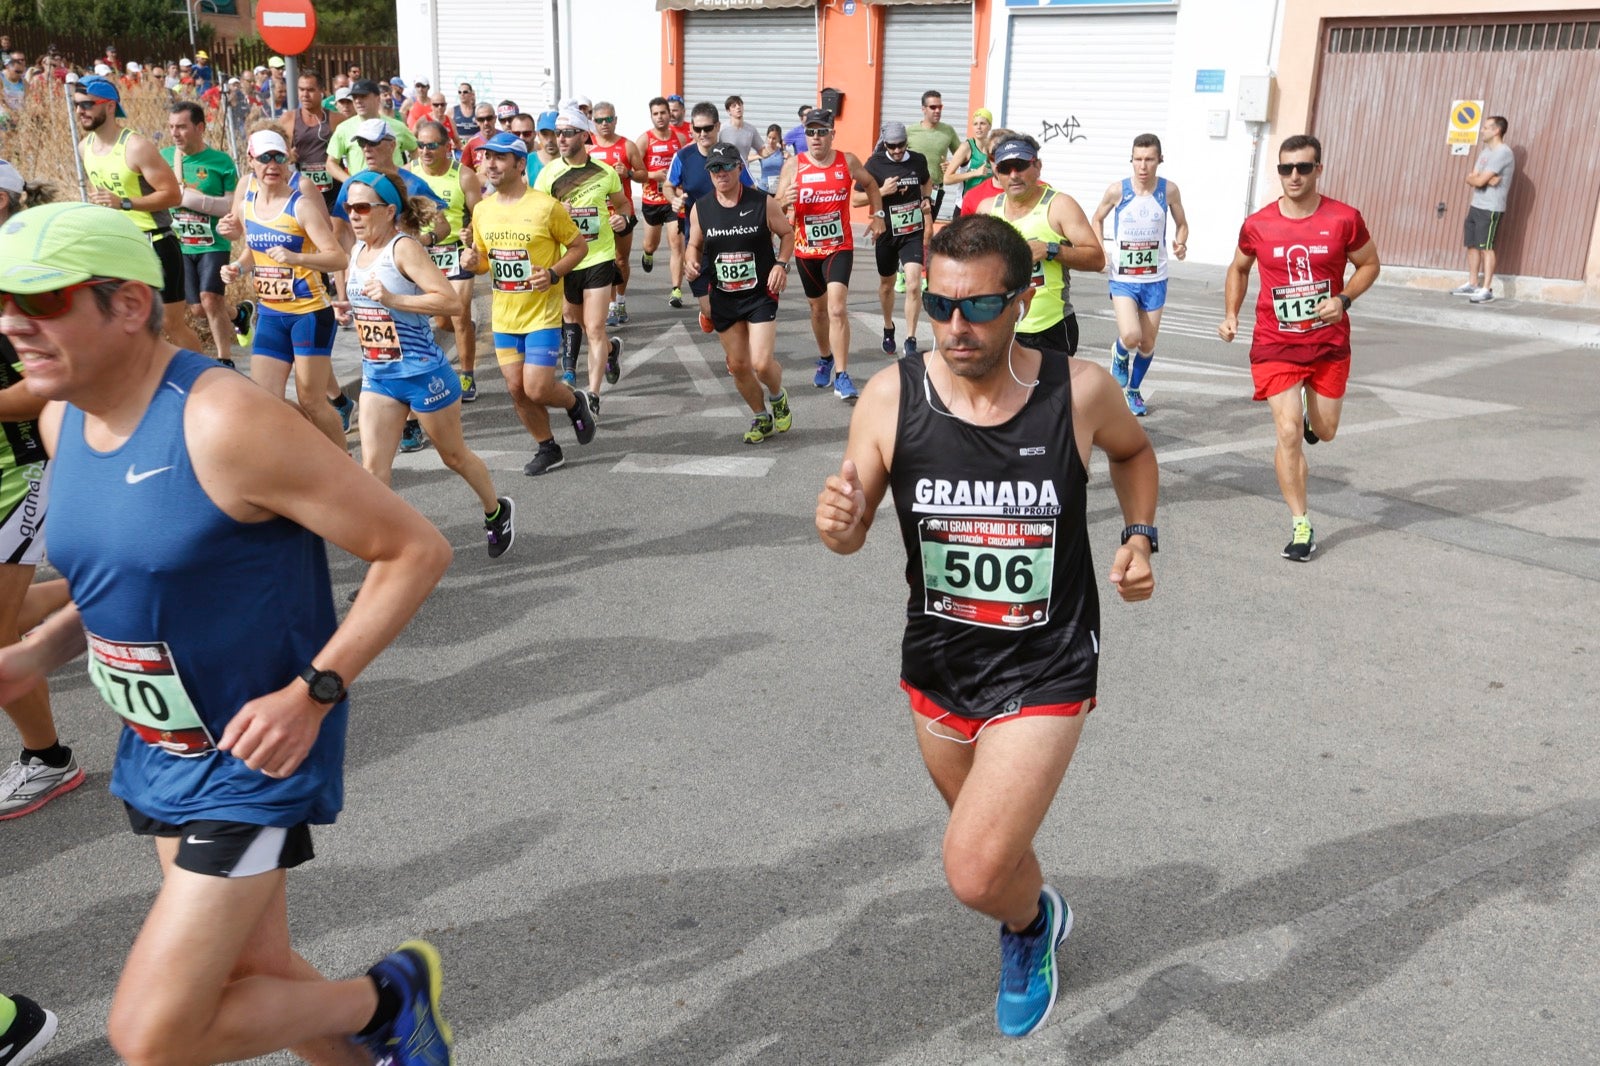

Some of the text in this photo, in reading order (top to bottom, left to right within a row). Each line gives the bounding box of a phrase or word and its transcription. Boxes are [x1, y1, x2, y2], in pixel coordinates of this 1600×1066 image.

[799, 187, 849, 204] Polisalud
[898, 210, 915, 225] 27
[178, 223, 206, 236] 763
[485, 229, 531, 242] agustinos
[706, 225, 759, 238] Almuñécar
[811, 223, 838, 239] 600
[1127, 251, 1152, 265] 134
[495, 262, 524, 278] 806
[721, 264, 749, 279] 882
[256, 280, 290, 295] 2212
[915, 478, 1059, 506] GRANADA
[1002, 506, 1061, 516] RUN PROJECT
[949, 521, 973, 534] GRAN
[974, 522, 1006, 536] PREMIO
[1007, 523, 1019, 536] DE
[987, 536, 1025, 547] CRUZCAMPO
[944, 550, 1033, 594] 506
